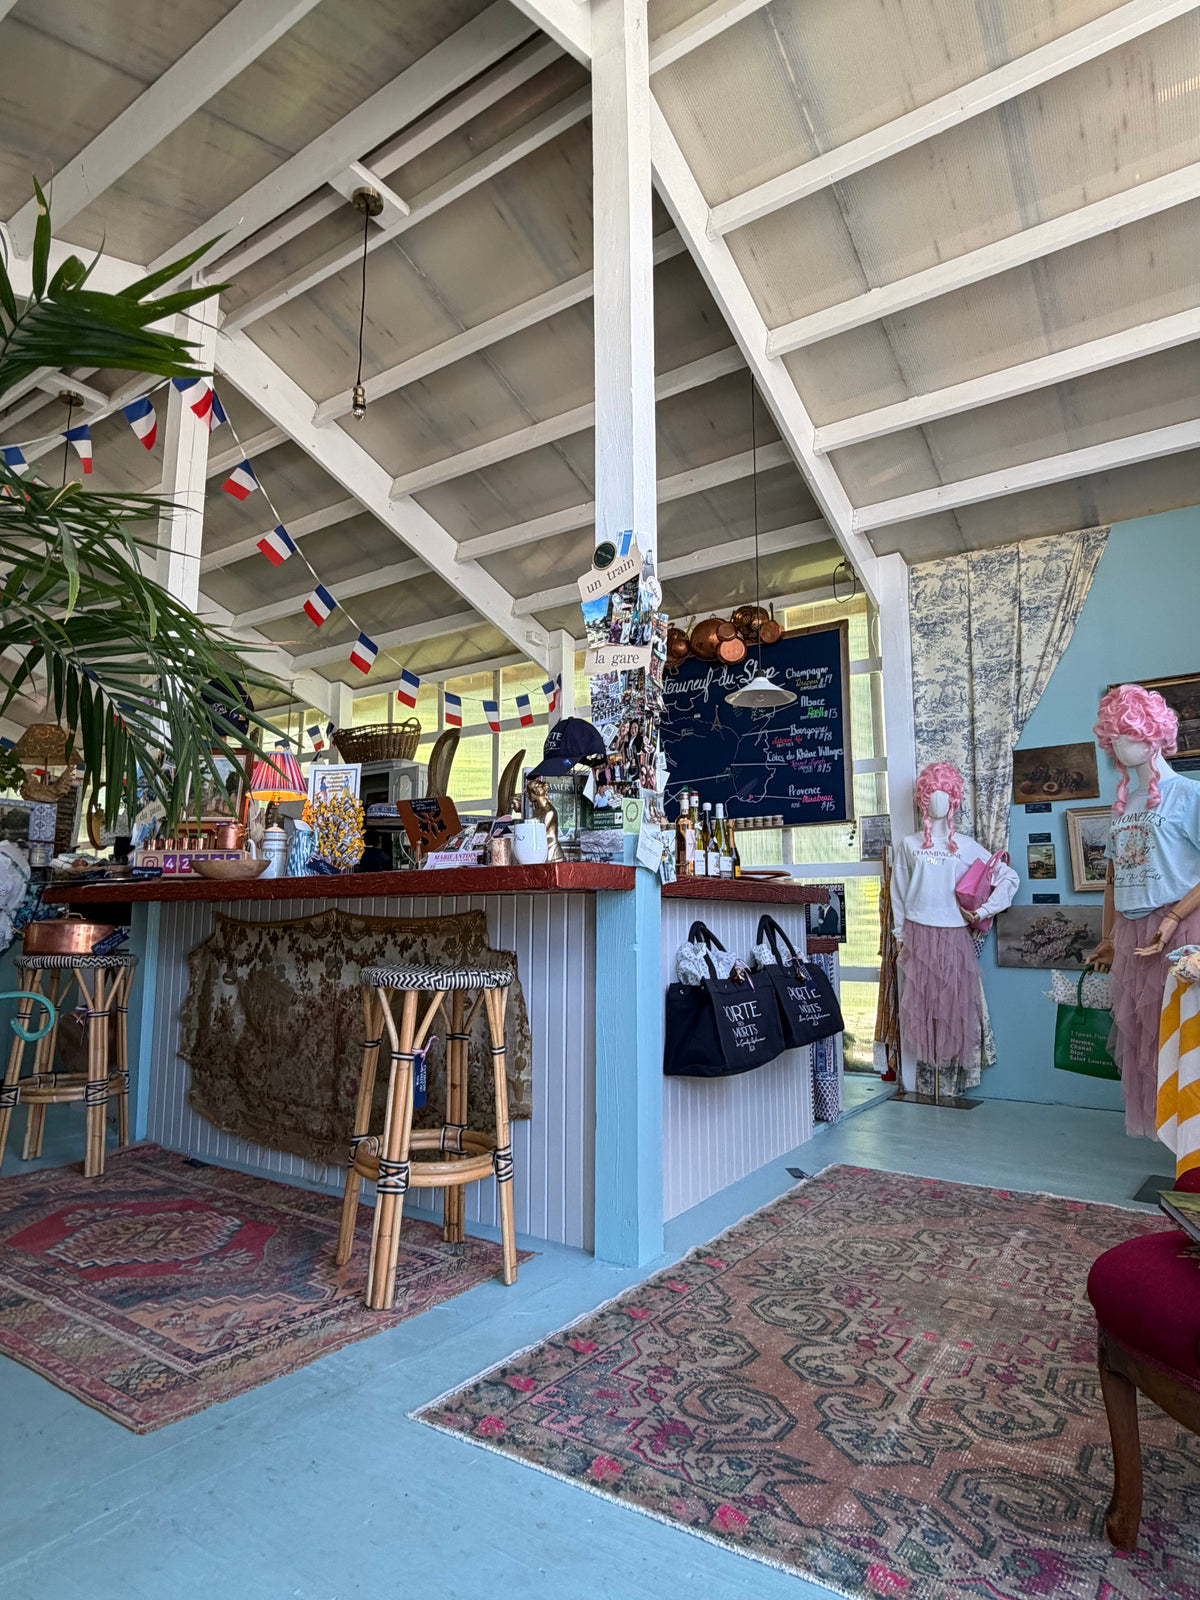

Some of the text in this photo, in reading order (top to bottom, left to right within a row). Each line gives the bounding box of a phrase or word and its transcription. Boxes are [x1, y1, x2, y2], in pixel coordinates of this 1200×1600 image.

[587, 558, 635, 594] un train
[595, 650, 640, 667] la gare
[785, 666, 829, 680] Champagne
[800, 695, 826, 707] Alsace
[789, 723, 829, 740] Bourgogne
[786, 750, 795, 760] du
[796, 748, 818, 761] Rhône
[817, 745, 844, 760] Villages
[817, 762, 833, 773] $15
[788, 784, 822, 797] Provence
[820, 800, 836, 812] $15
